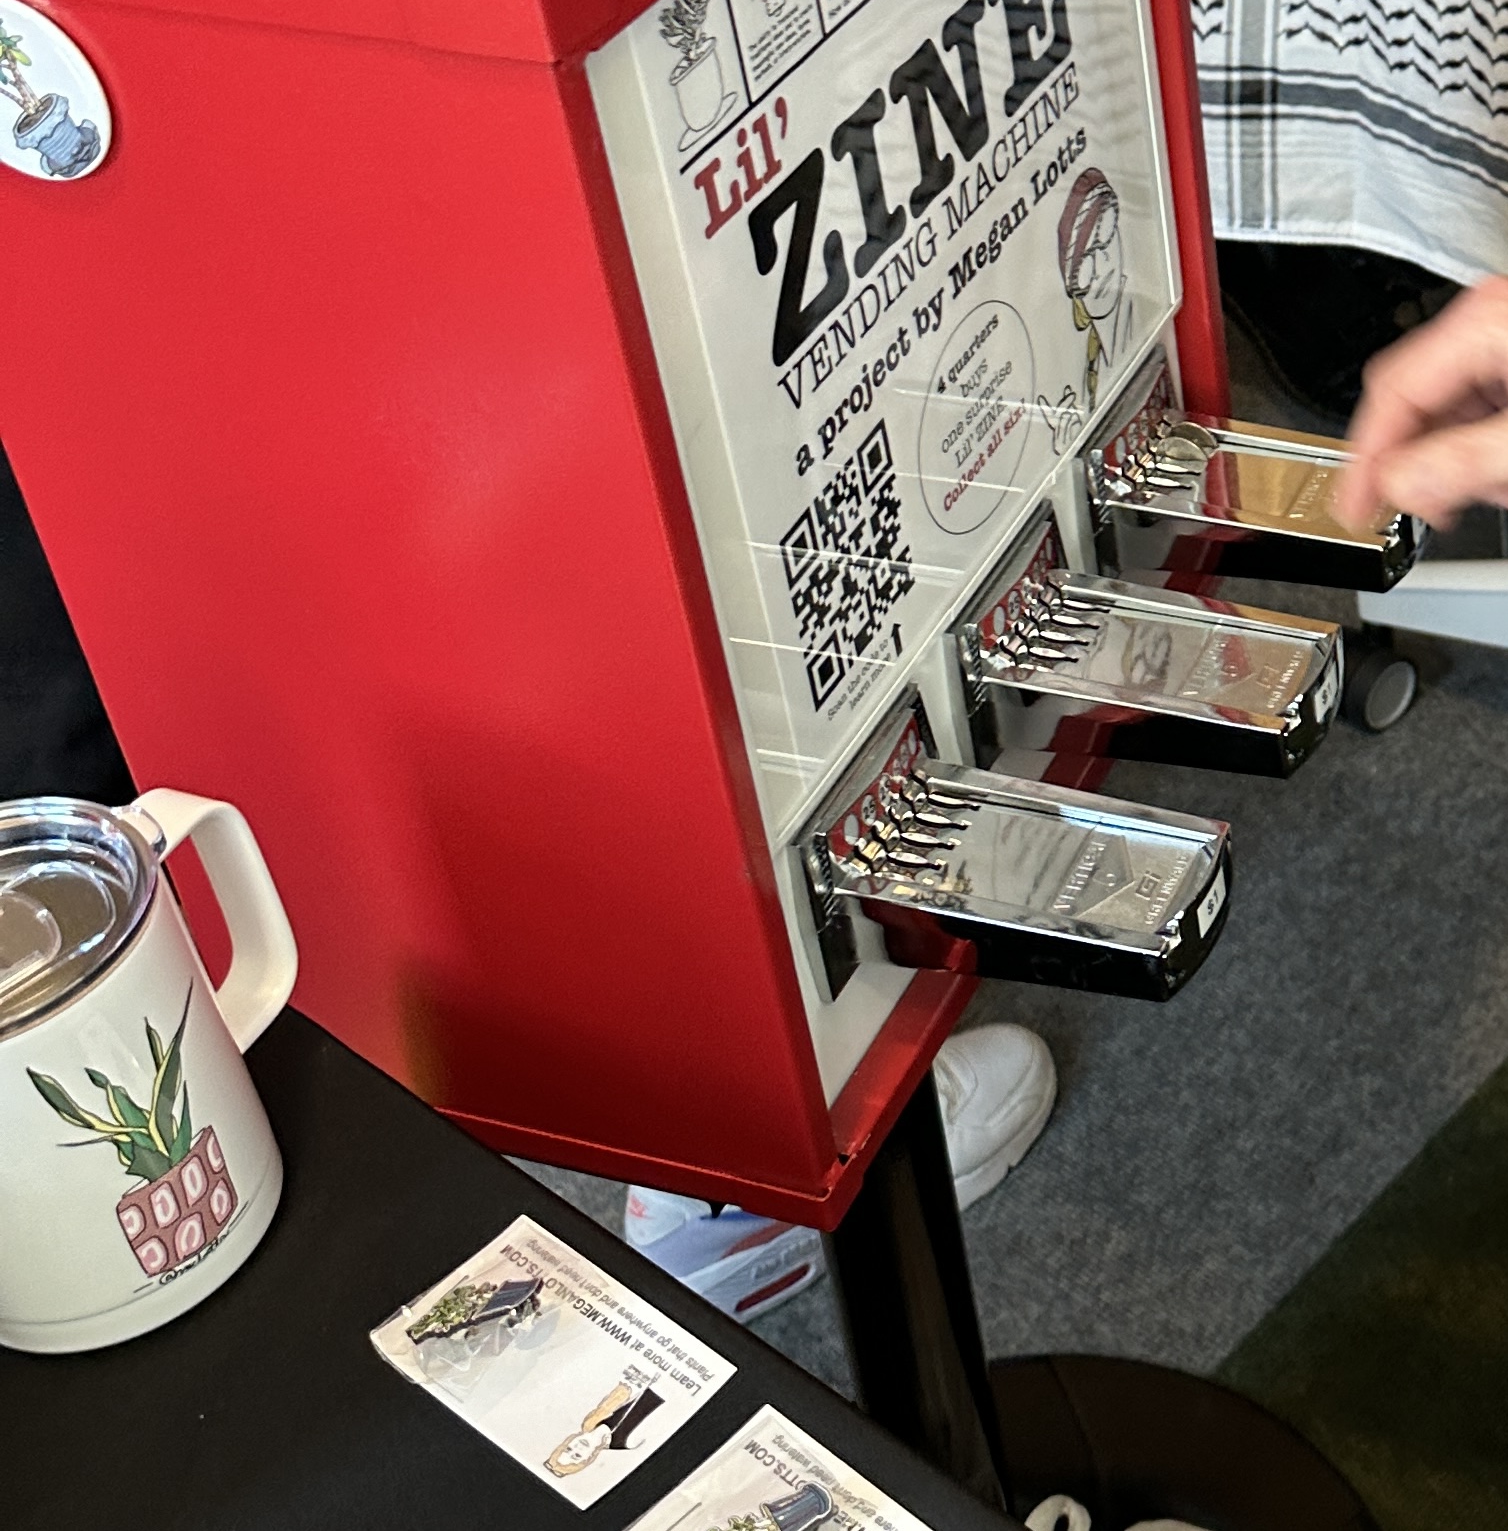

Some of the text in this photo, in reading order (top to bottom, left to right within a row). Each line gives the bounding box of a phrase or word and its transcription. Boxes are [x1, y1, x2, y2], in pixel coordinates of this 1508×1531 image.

[693, 96, 788, 239] Lil'
[777, 217, 939, 409] VENDING
[941, 62, 1080, 240] MACHINE
[795, 126, 1088, 477] a project by Megan Lotts
[937, 314, 999, 394] 4 quarters
[960, 358, 989, 398] buys
[941, 361, 1013, 454] one surprise
[943, 452, 986, 512] Collect
[987, 429, 1003, 458] all
[1207, 890, 1219, 915] $1
[500, 1244, 633, 1346] WWW.MEGANLOTS.COM
[599, 1294, 620, 1310] and
[617, 1306, 659, 1339] anywhere
[629, 1339, 645, 1352] at
[656, 1335, 672, 1348] go
[666, 1344, 688, 1362] that
[643, 1348, 671, 1371] more
[686, 1356, 715, 1382] Plants
[670, 1368, 702, 1396] Learn
[852, 1501, 876, 1518] and
